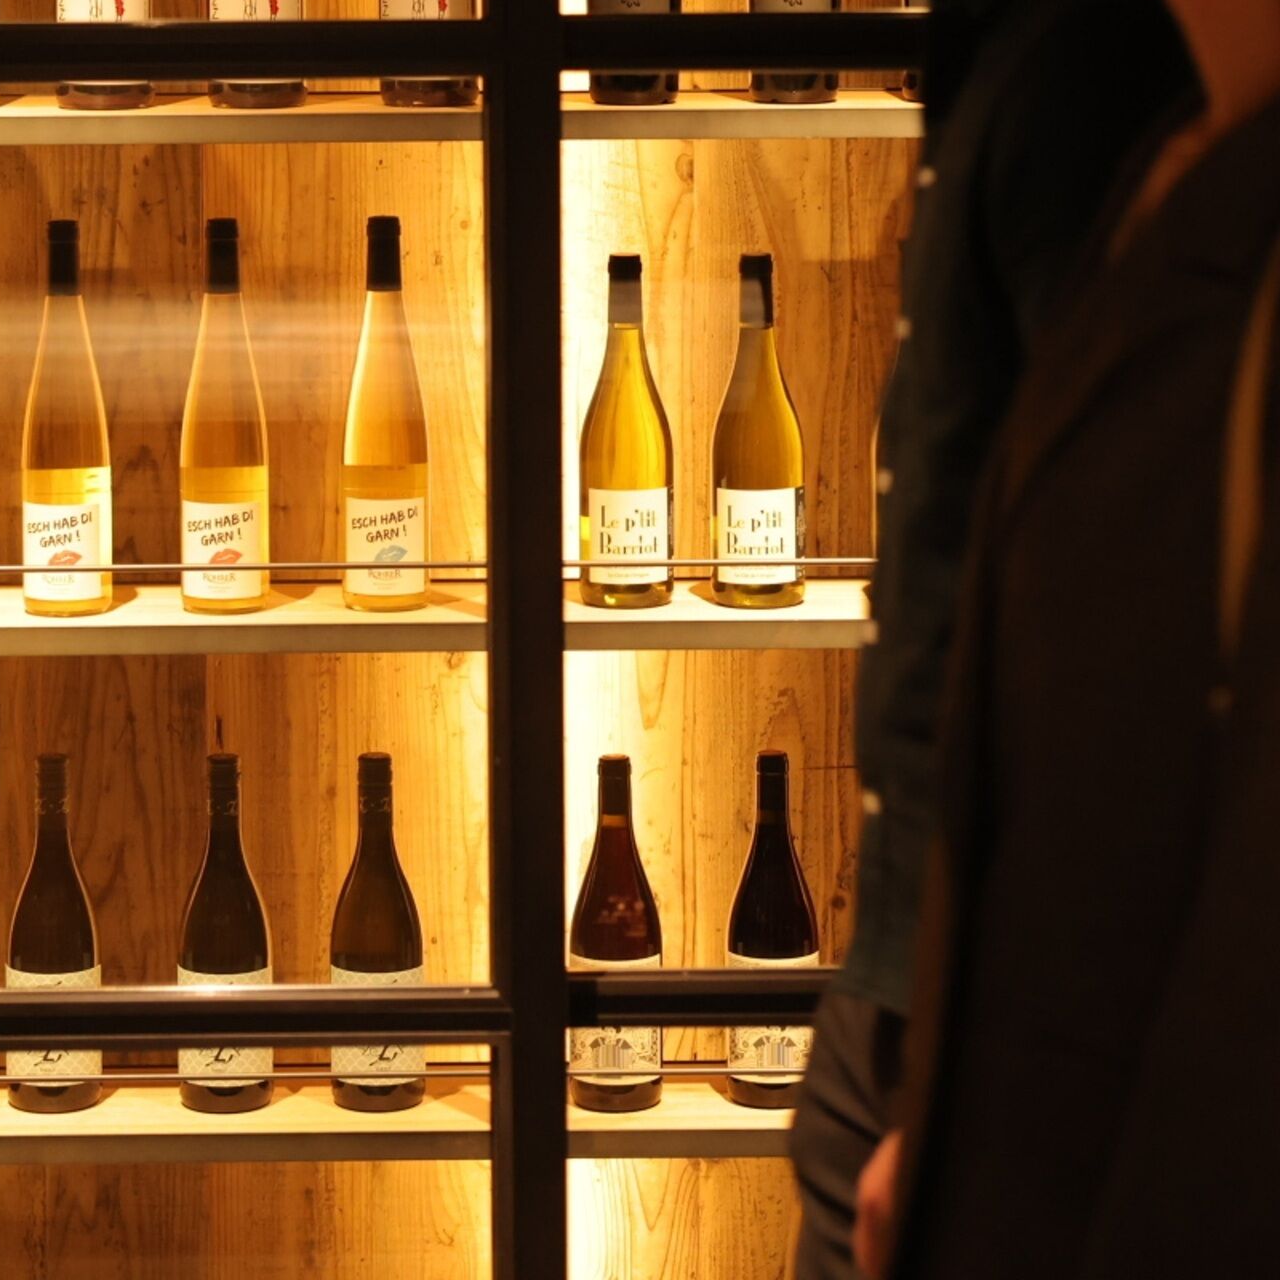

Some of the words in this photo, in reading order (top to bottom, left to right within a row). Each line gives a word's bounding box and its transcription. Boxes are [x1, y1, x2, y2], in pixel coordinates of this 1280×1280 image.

[27, 521, 50, 534] ESCH
[53, 516, 79, 530] HAB
[80, 511, 92, 524] DI
[187, 519, 211, 532] ESCH
[214, 514, 240, 528] HAB
[242, 509, 254, 522] DI
[351, 517, 377, 530] ESCH
[380, 511, 406, 525] HAB
[407, 506, 418, 519] DI
[600, 505, 619, 529] Le
[727, 505, 746, 529] Le
[600, 531, 657, 555] Barriot
[727, 531, 784, 555] Barriot
